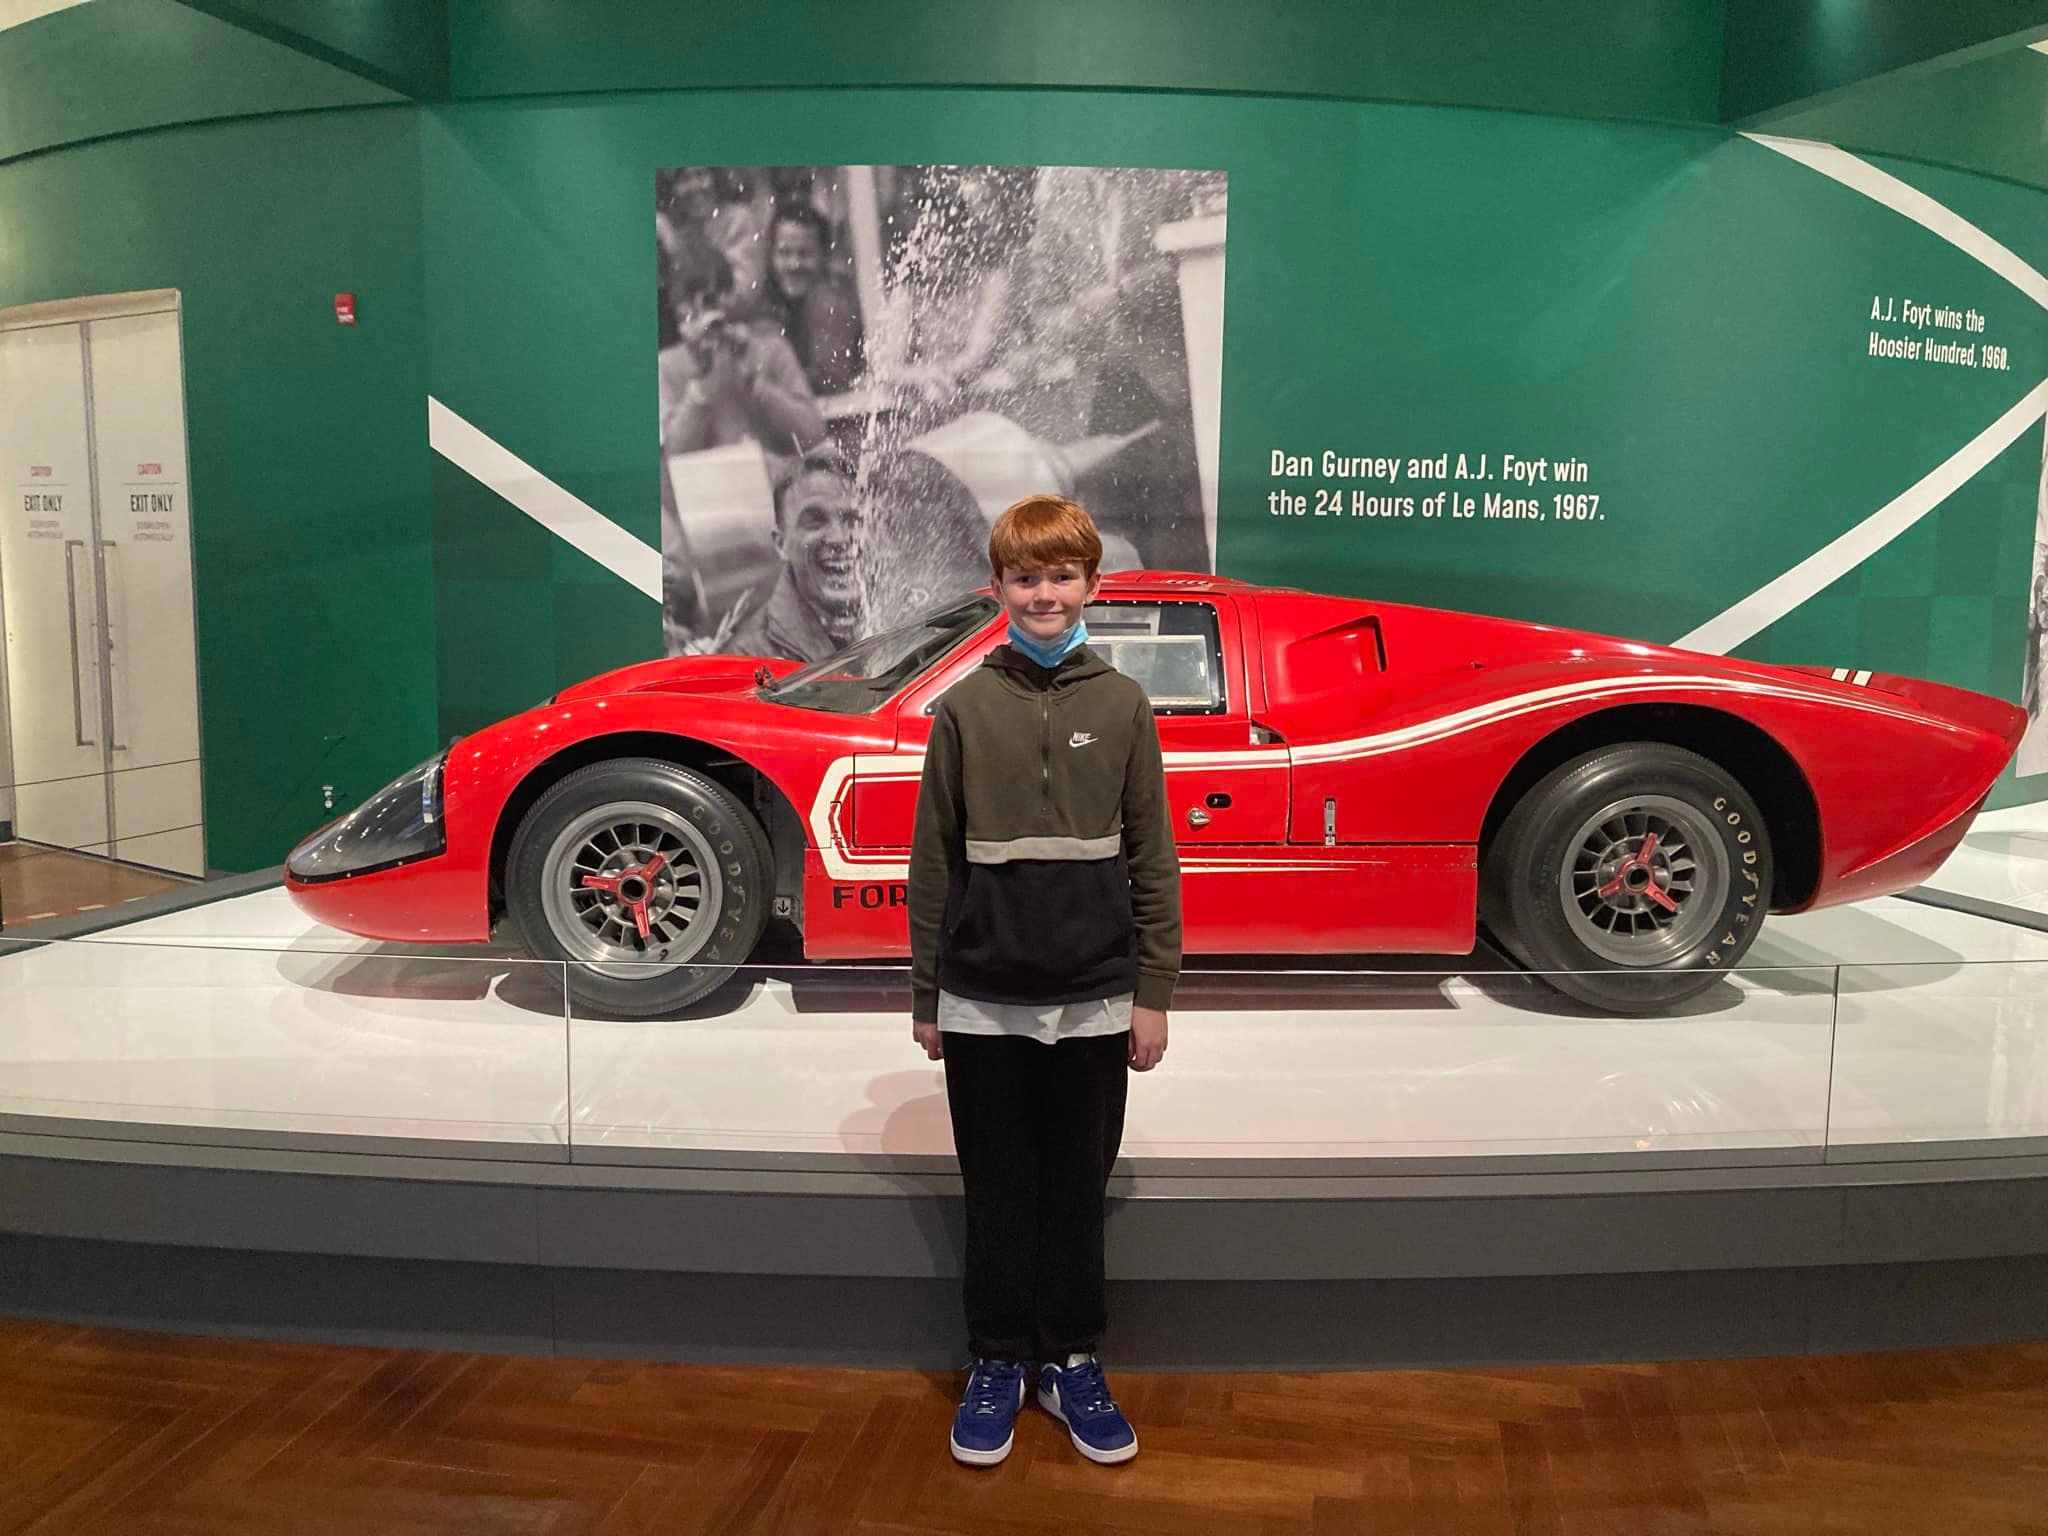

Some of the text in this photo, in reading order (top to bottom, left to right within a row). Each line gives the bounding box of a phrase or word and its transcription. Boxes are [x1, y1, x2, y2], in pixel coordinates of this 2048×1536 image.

[1871, 296, 1985, 333] A.J. Foyt wins the
[1869, 332, 1922, 361] Hoosier
[1925, 337, 1977, 368] Hundred,
[1270, 450, 1588, 486] Dan Gurney and A.J. Foyt win
[24, 495, 63, 512] EXIT ONLY
[130, 494, 173, 512] EXIT ONLY
[1268, 489, 1605, 521] the 24 Hours of Le Mans, 1967.
[833, 884, 909, 909] FOR
[1705, 797, 1760, 966] GOODYEAR
